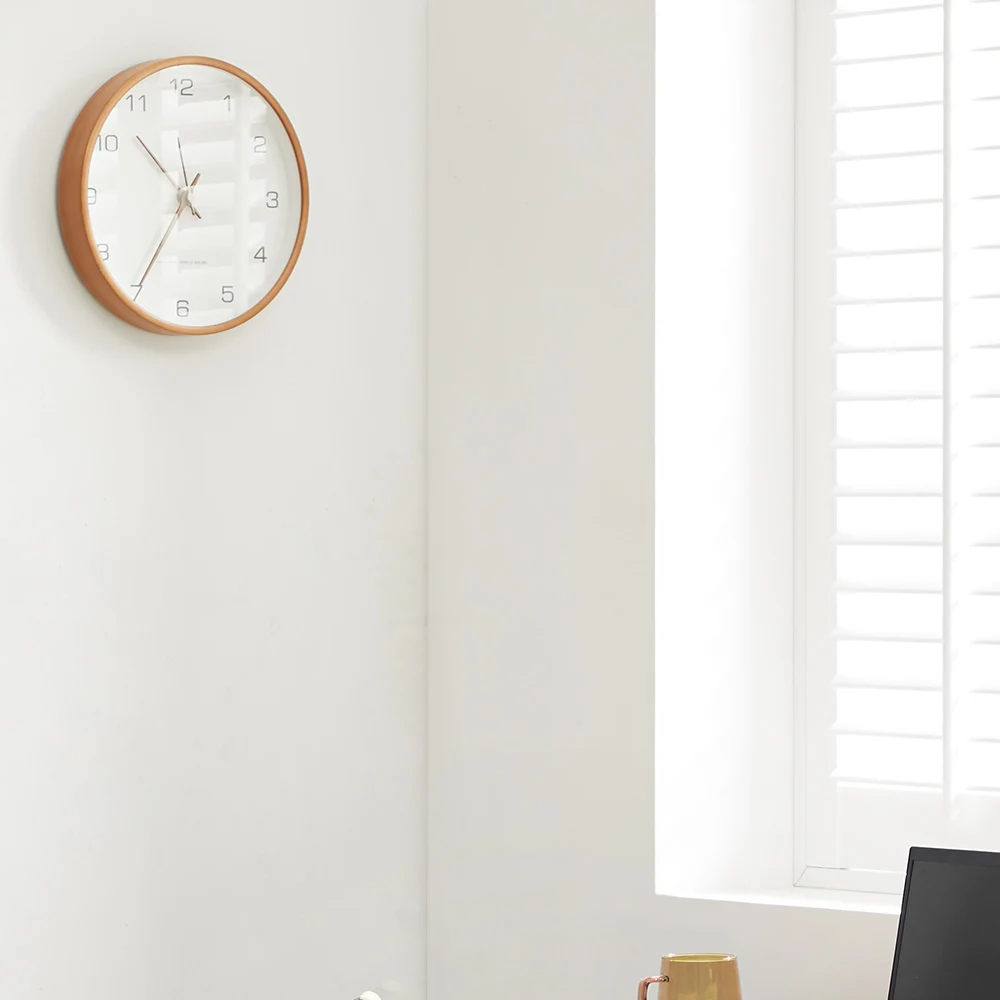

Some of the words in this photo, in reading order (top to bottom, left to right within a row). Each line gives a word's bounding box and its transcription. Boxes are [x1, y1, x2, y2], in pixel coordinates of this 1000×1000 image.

[169, 78, 194, 96] 12
[125, 94, 147, 112] 11
[223, 94, 231, 112] 1
[98, 134, 119, 152] 10
[253, 135, 267, 154] 2
[266, 190, 279, 209] 3
[253, 246, 268, 263] 4
[130, 284, 143, 302] 7
[221, 285, 234, 304] 5
[176, 299, 190, 318] 6
